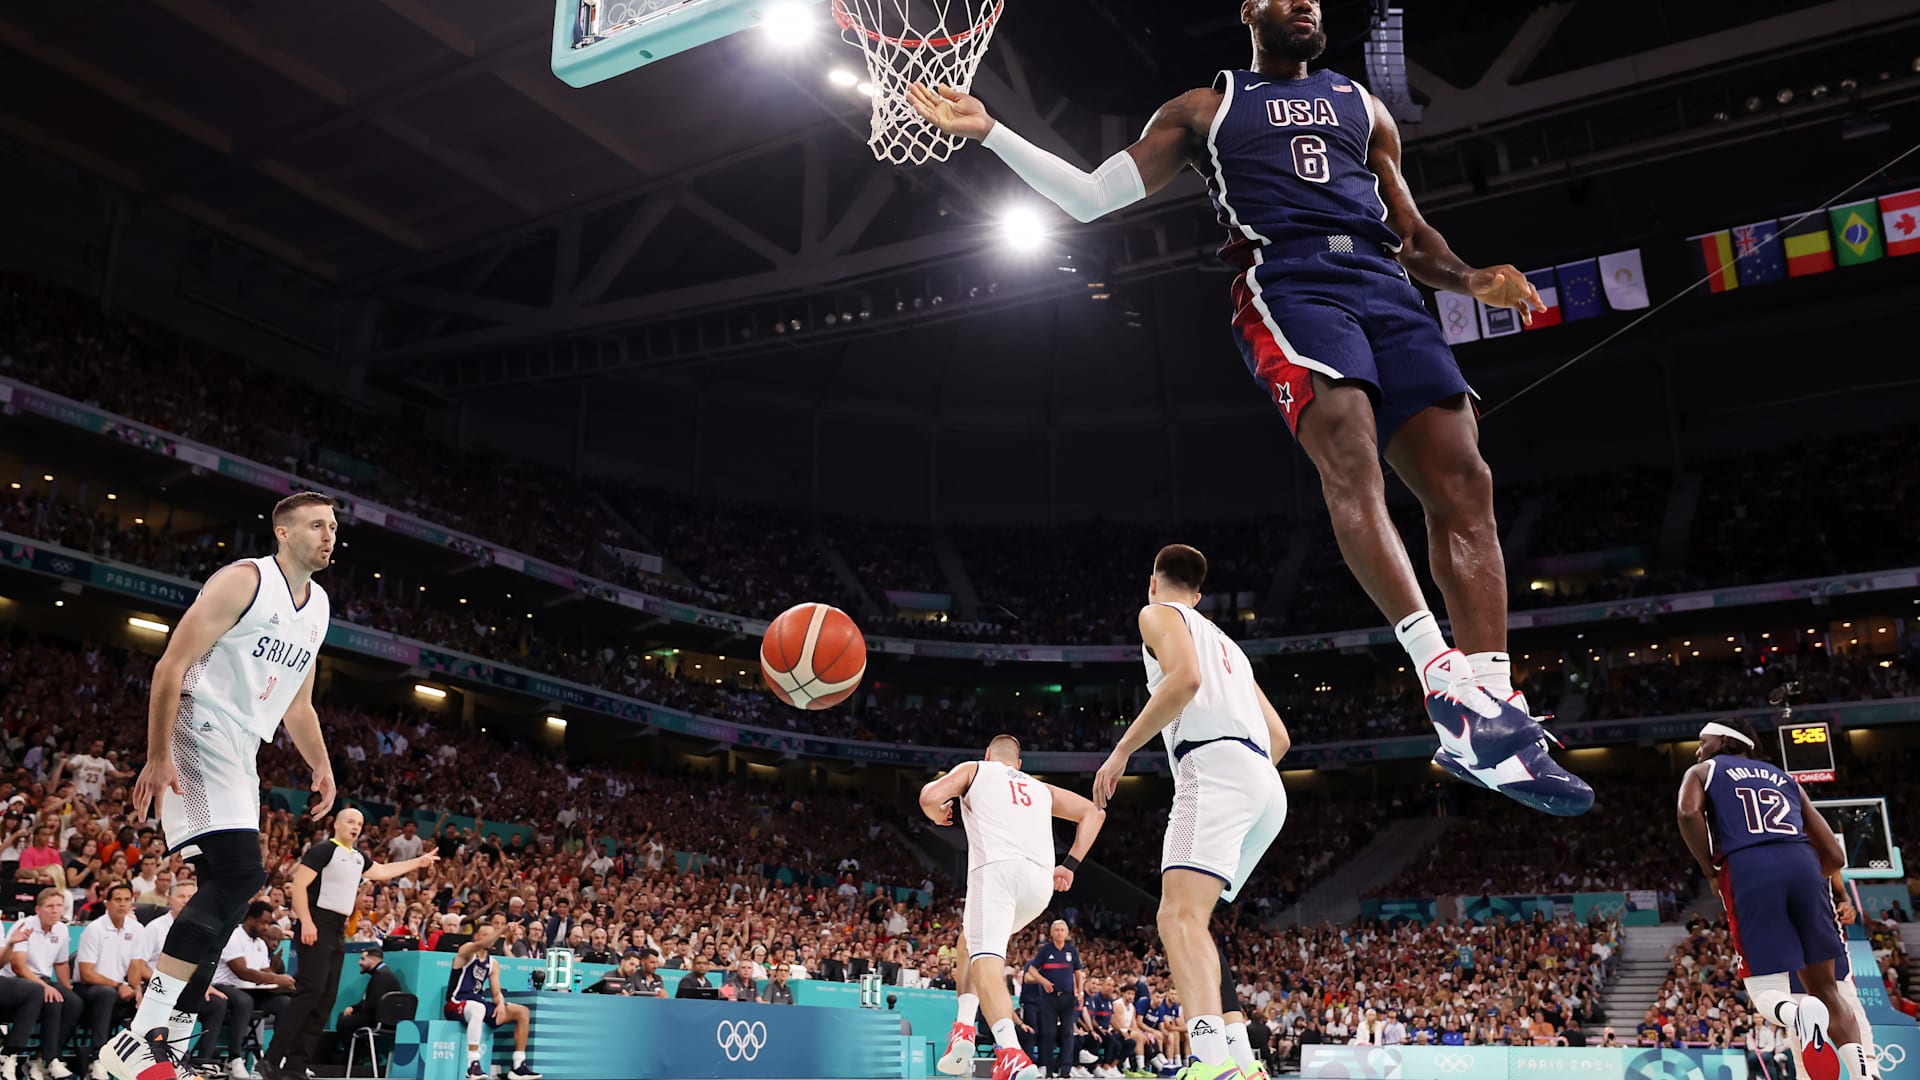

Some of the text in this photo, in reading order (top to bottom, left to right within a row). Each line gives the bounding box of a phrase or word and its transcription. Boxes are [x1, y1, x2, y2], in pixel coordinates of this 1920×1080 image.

[1265, 98, 1339, 127] USA
[1290, 135, 1330, 183] 6
[105, 572, 185, 601] PARIS 2024
[348, 634, 410, 659] PARIS 2024
[1791, 727, 1827, 745] 5:26
[1725, 766, 1788, 788] HOLIDAY
[1799, 772, 1834, 783] OMEGA
[1009, 780, 1032, 807] 15
[1734, 787, 1799, 836] 12
[1857, 987, 1881, 997] ARIS
[1860, 997, 1883, 1006] 024
[169, 1016, 193, 1024] PEAK
[1191, 1028, 1217, 1038] PEAK
[433, 1041, 455, 1050] PARIS
[1517, 1059, 1615, 1071] PARIS 2024
